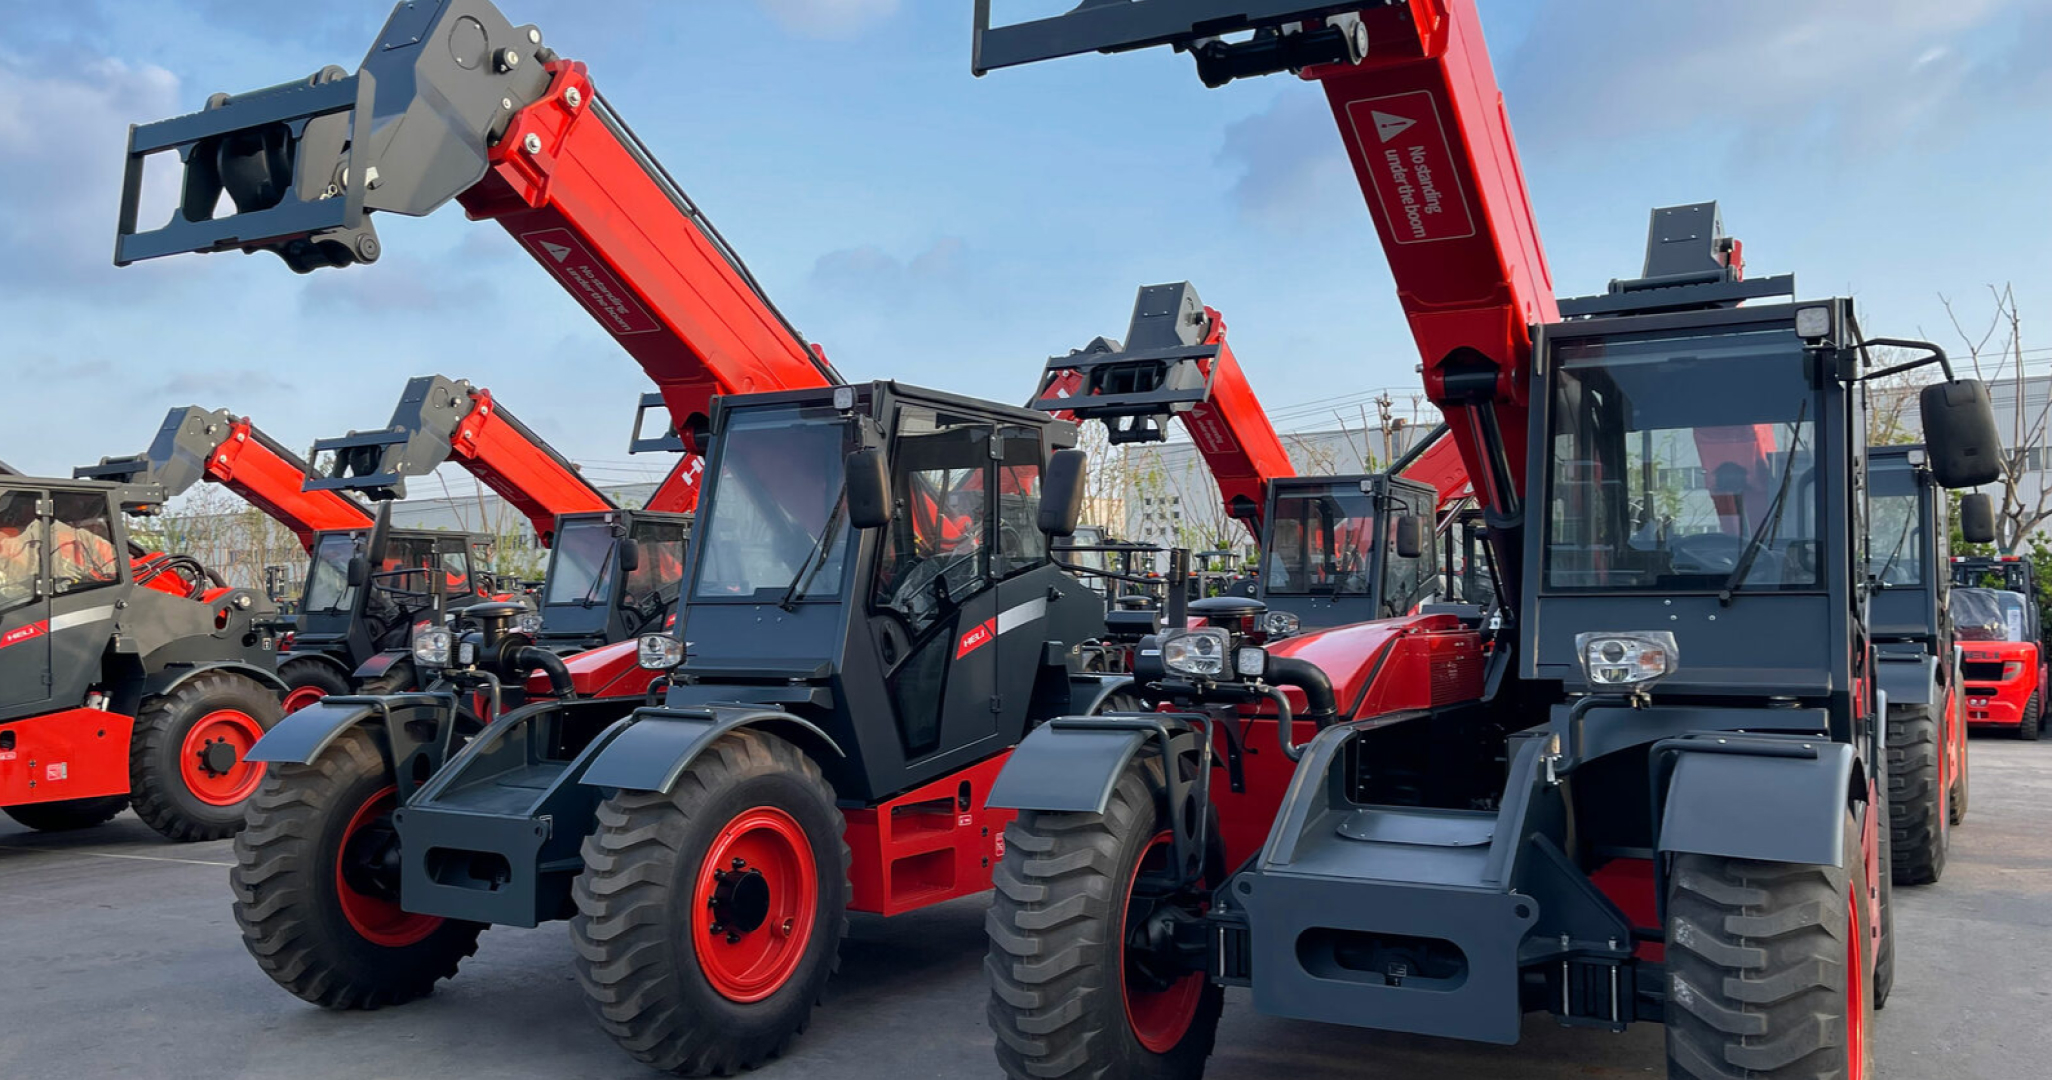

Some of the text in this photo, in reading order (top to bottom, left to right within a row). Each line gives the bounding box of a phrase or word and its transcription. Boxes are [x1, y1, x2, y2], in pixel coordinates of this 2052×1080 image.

[1384, 149, 1427, 238] under the boom
[1408, 145, 1443, 214] No standing
[566, 267, 632, 331] under the boom
[578, 265, 630, 314] No standing
